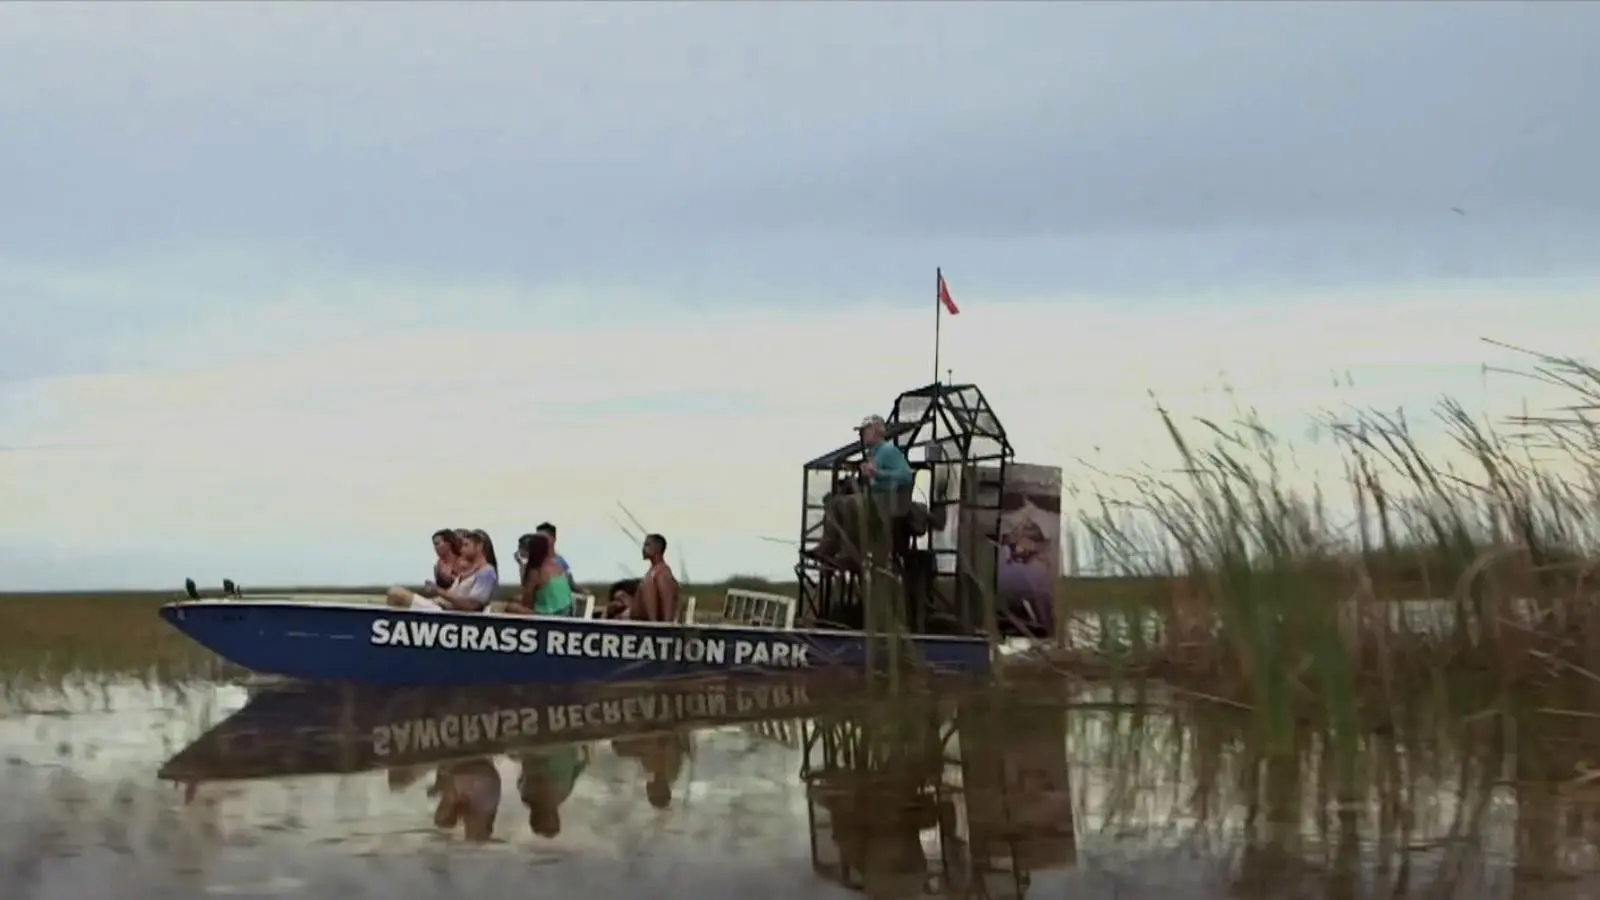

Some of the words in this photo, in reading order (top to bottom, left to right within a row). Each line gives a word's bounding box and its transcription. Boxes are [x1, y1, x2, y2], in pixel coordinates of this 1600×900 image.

[371, 619, 538, 653] SAWGRASS
[547, 630, 725, 663] RECREATION
[735, 641, 809, 668] PARK
